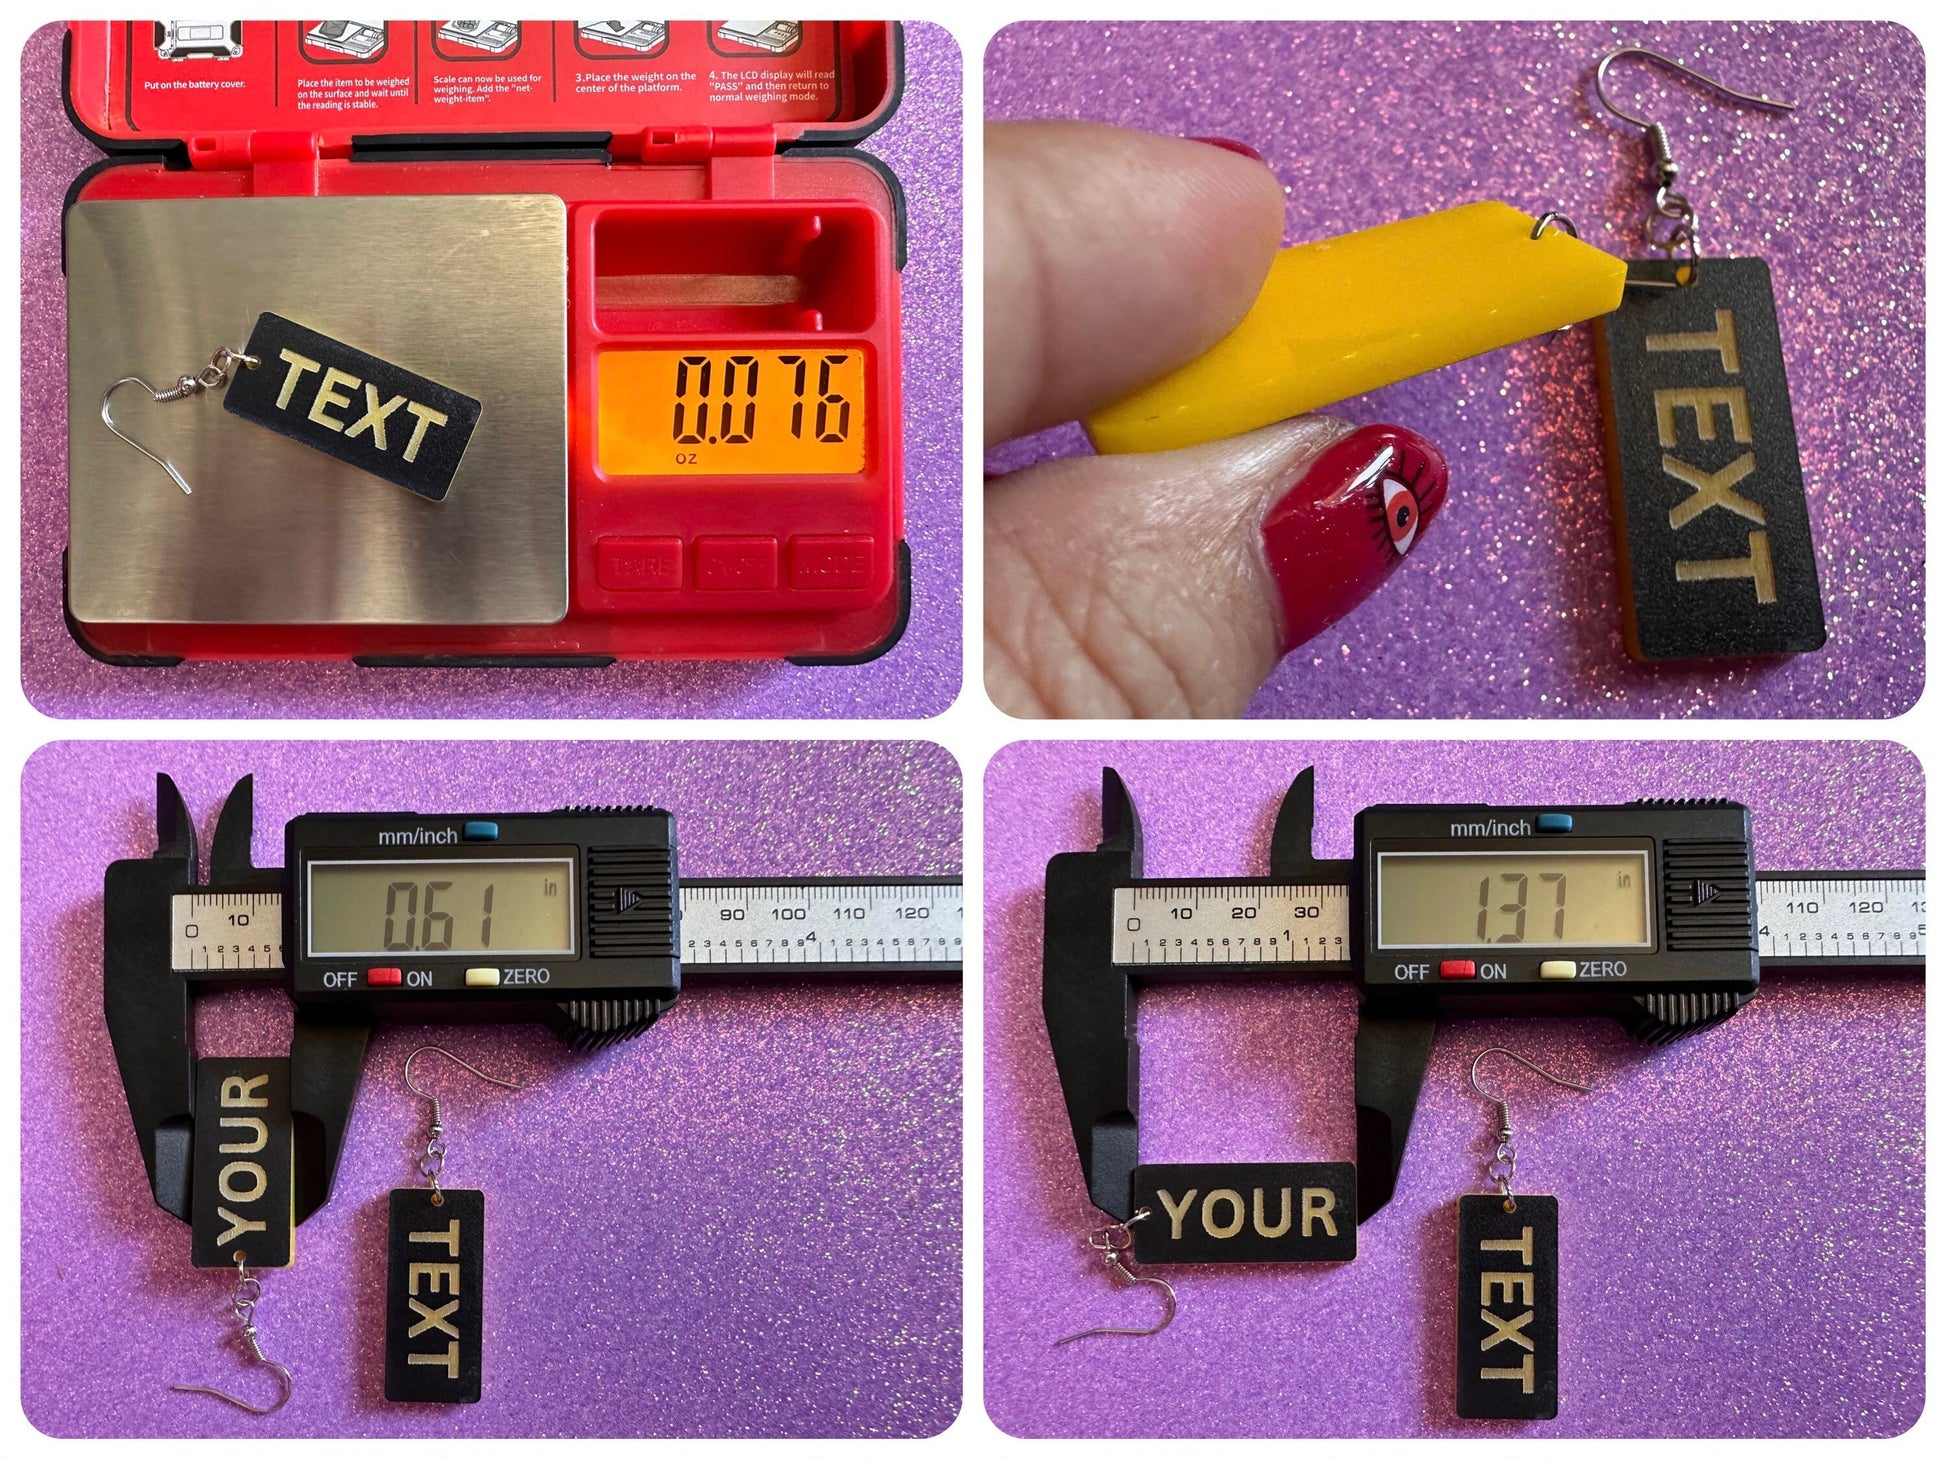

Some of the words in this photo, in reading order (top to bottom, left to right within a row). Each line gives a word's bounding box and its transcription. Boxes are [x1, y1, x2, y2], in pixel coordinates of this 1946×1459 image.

[298, 79, 318, 87] Place
[320, 79, 333, 87] the
[365, 78, 374, 86] be
[376, 77, 409, 88] weighed
[613, 73, 629, 81] the
[631, 72, 663, 82] weight
[681, 72, 696, 80] the
[709, 71, 718, 79] 4.
[721, 71, 738, 79] The
[741, 71, 758, 79] LCD
[761, 70, 793, 81] display
[796, 70, 812, 78] will
[815, 70, 835, 78] read
[144, 81, 159, 89] Put
[173, 81, 187, 89] the
[189, 81, 219, 90] battery
[310, 90, 323, 98] the
[324, 89, 352, 98] surface
[355, 89, 369, 97] and
[371, 88, 388, 97] wait
[390, 88, 409, 96] until
[434, 85, 474, 94] weighing.
[608, 84, 618, 92] of
[620, 83, 635, 92] the
[638, 83, 682, 93] platform.
[746, 82, 762, 90] and
[710, 93, 742, 101] normal
[745, 92, 787, 103] weighing
[790, 92, 818, 100] mode.
[298, 101, 311, 109] the
[313, 100, 342, 111] reading
[344, 100, 350, 109] is
[352, 100, 378, 108] stable.
[275, 348, 448, 463] TEXT
[673, 355, 850, 444] 0.076
[1646, 310, 1777, 604] TEXT
[1451, 819, 1531, 837] mm/inch
[379, 828, 458, 845] mm/inch
[545, 878, 557, 896] in
[1618, 871, 1631, 888] in
[721, 909, 744, 920] 90
[772, 909, 805, 920] 100
[834, 908, 865, 919] 110
[896, 908, 929, 918] 120
[1171, 907, 1192, 920] 10
[1232, 907, 1256, 919] 20
[1294, 906, 1319, 918] 30
[1477, 873, 1566, 943] 1.37
[1787, 902, 1818, 913] 110
[1849, 902, 1883, 913] 120
[229, 915, 249, 926] 10
[384, 881, 494, 952] 0.61
[806, 932, 816, 942] 4
[1144, 939, 1149, 947] 1
[1207, 938, 1214, 946] 5
[1222, 938, 1229, 946] 6
[1238, 938, 1245, 946] 7
[1254, 938, 1261, 946] 8
[1283, 930, 1289, 941] 1
[1319, 937, 1326, 945] 2
[1759, 926, 1769, 936] 4
[504, 969, 549, 984] ZERO
[1395, 965, 1430, 980] OFF
[1481, 964, 1507, 979] ON
[1580, 961, 1626, 977] ZERO
[324, 972, 358, 988] OFF
[407, 972, 432, 986] ON
[217, 1074, 269, 1247] YOUR
[1156, 1186, 1338, 1240] YOUR
[408, 1219, 460, 1378] TEXT
[1480, 1226, 1534, 1393] TEXT
